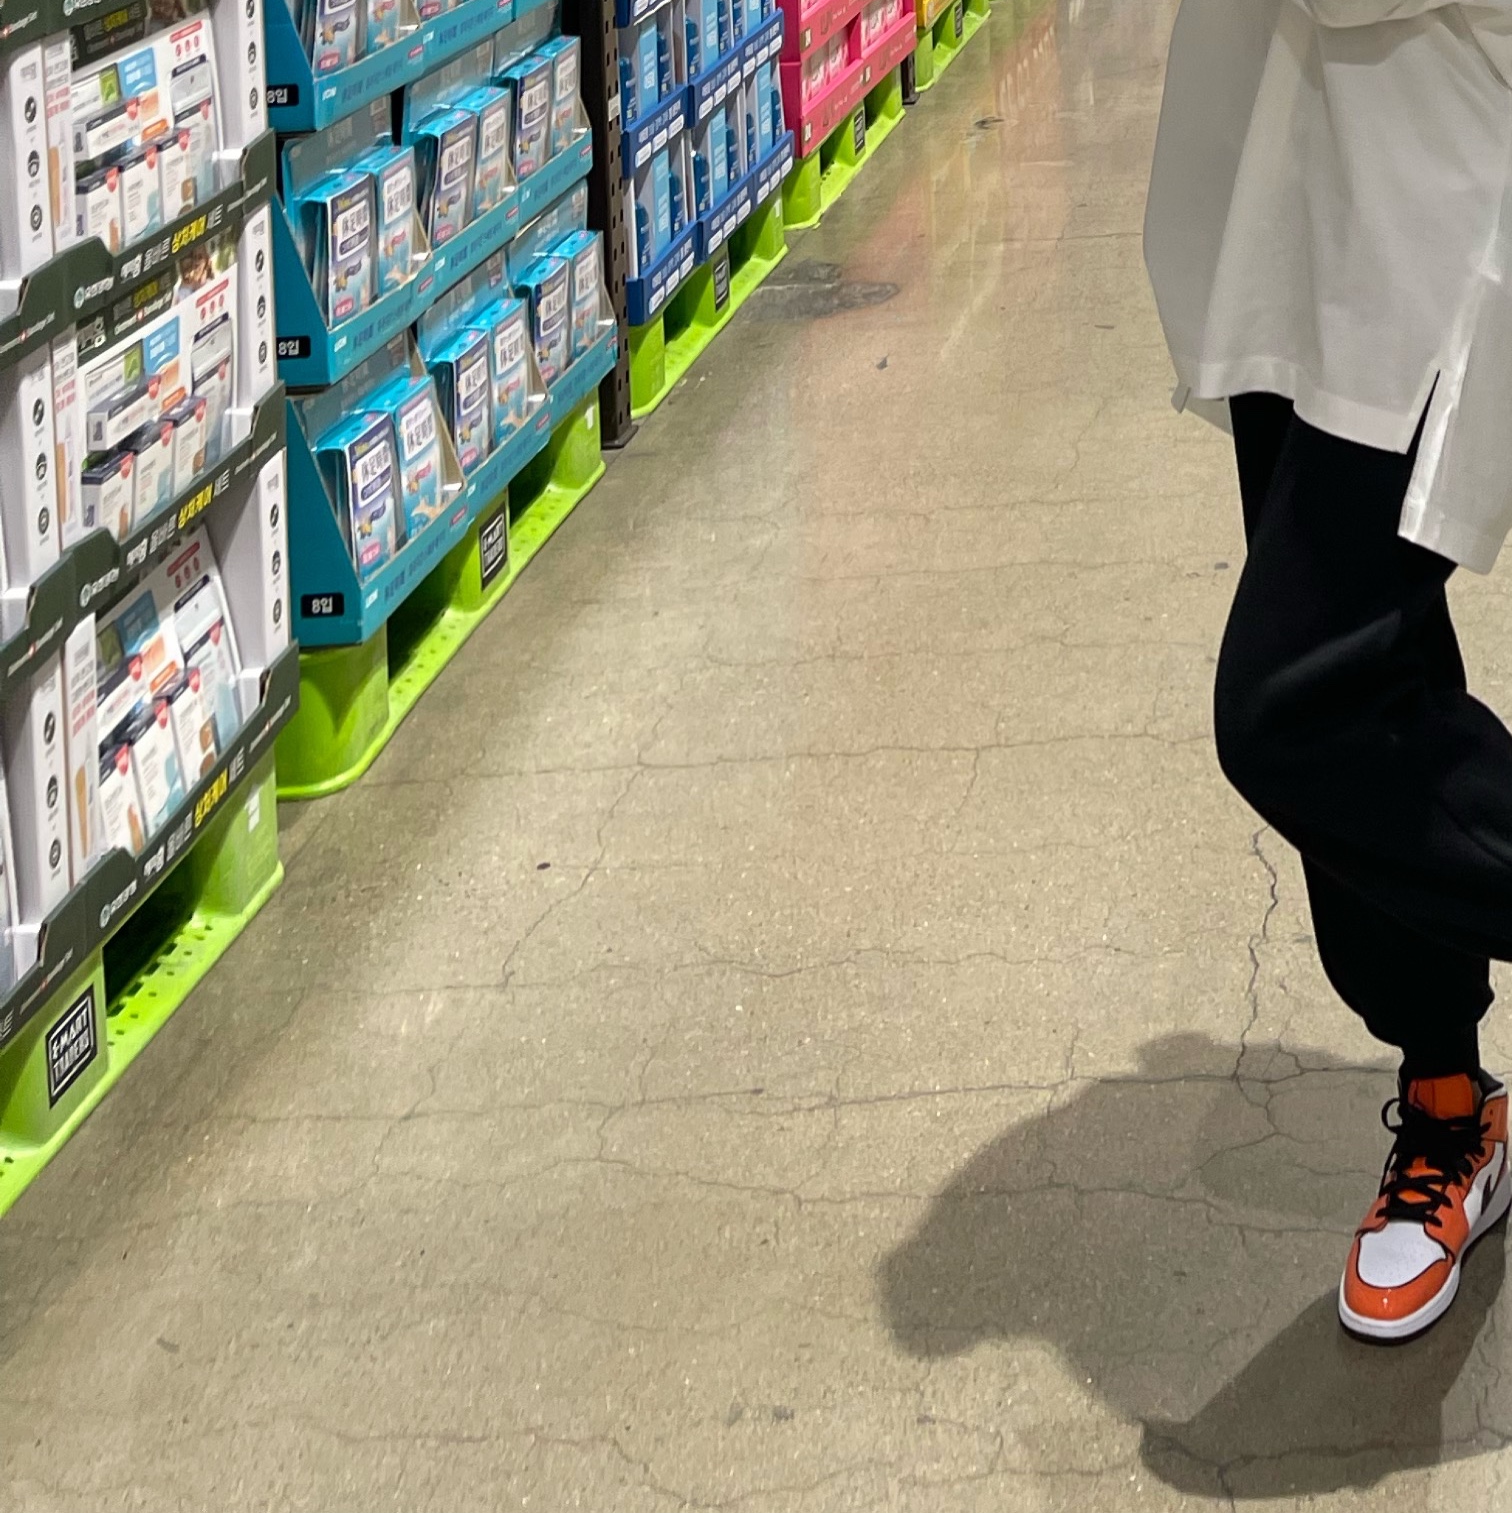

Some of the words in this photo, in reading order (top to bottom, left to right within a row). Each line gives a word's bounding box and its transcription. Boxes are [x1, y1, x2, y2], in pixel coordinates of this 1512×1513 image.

[171, 216, 207, 253] 상처케어
[277, 339, 300, 356] 8입
[177, 483, 213, 529] 상처케어
[311, 596, 333, 614] 8입
